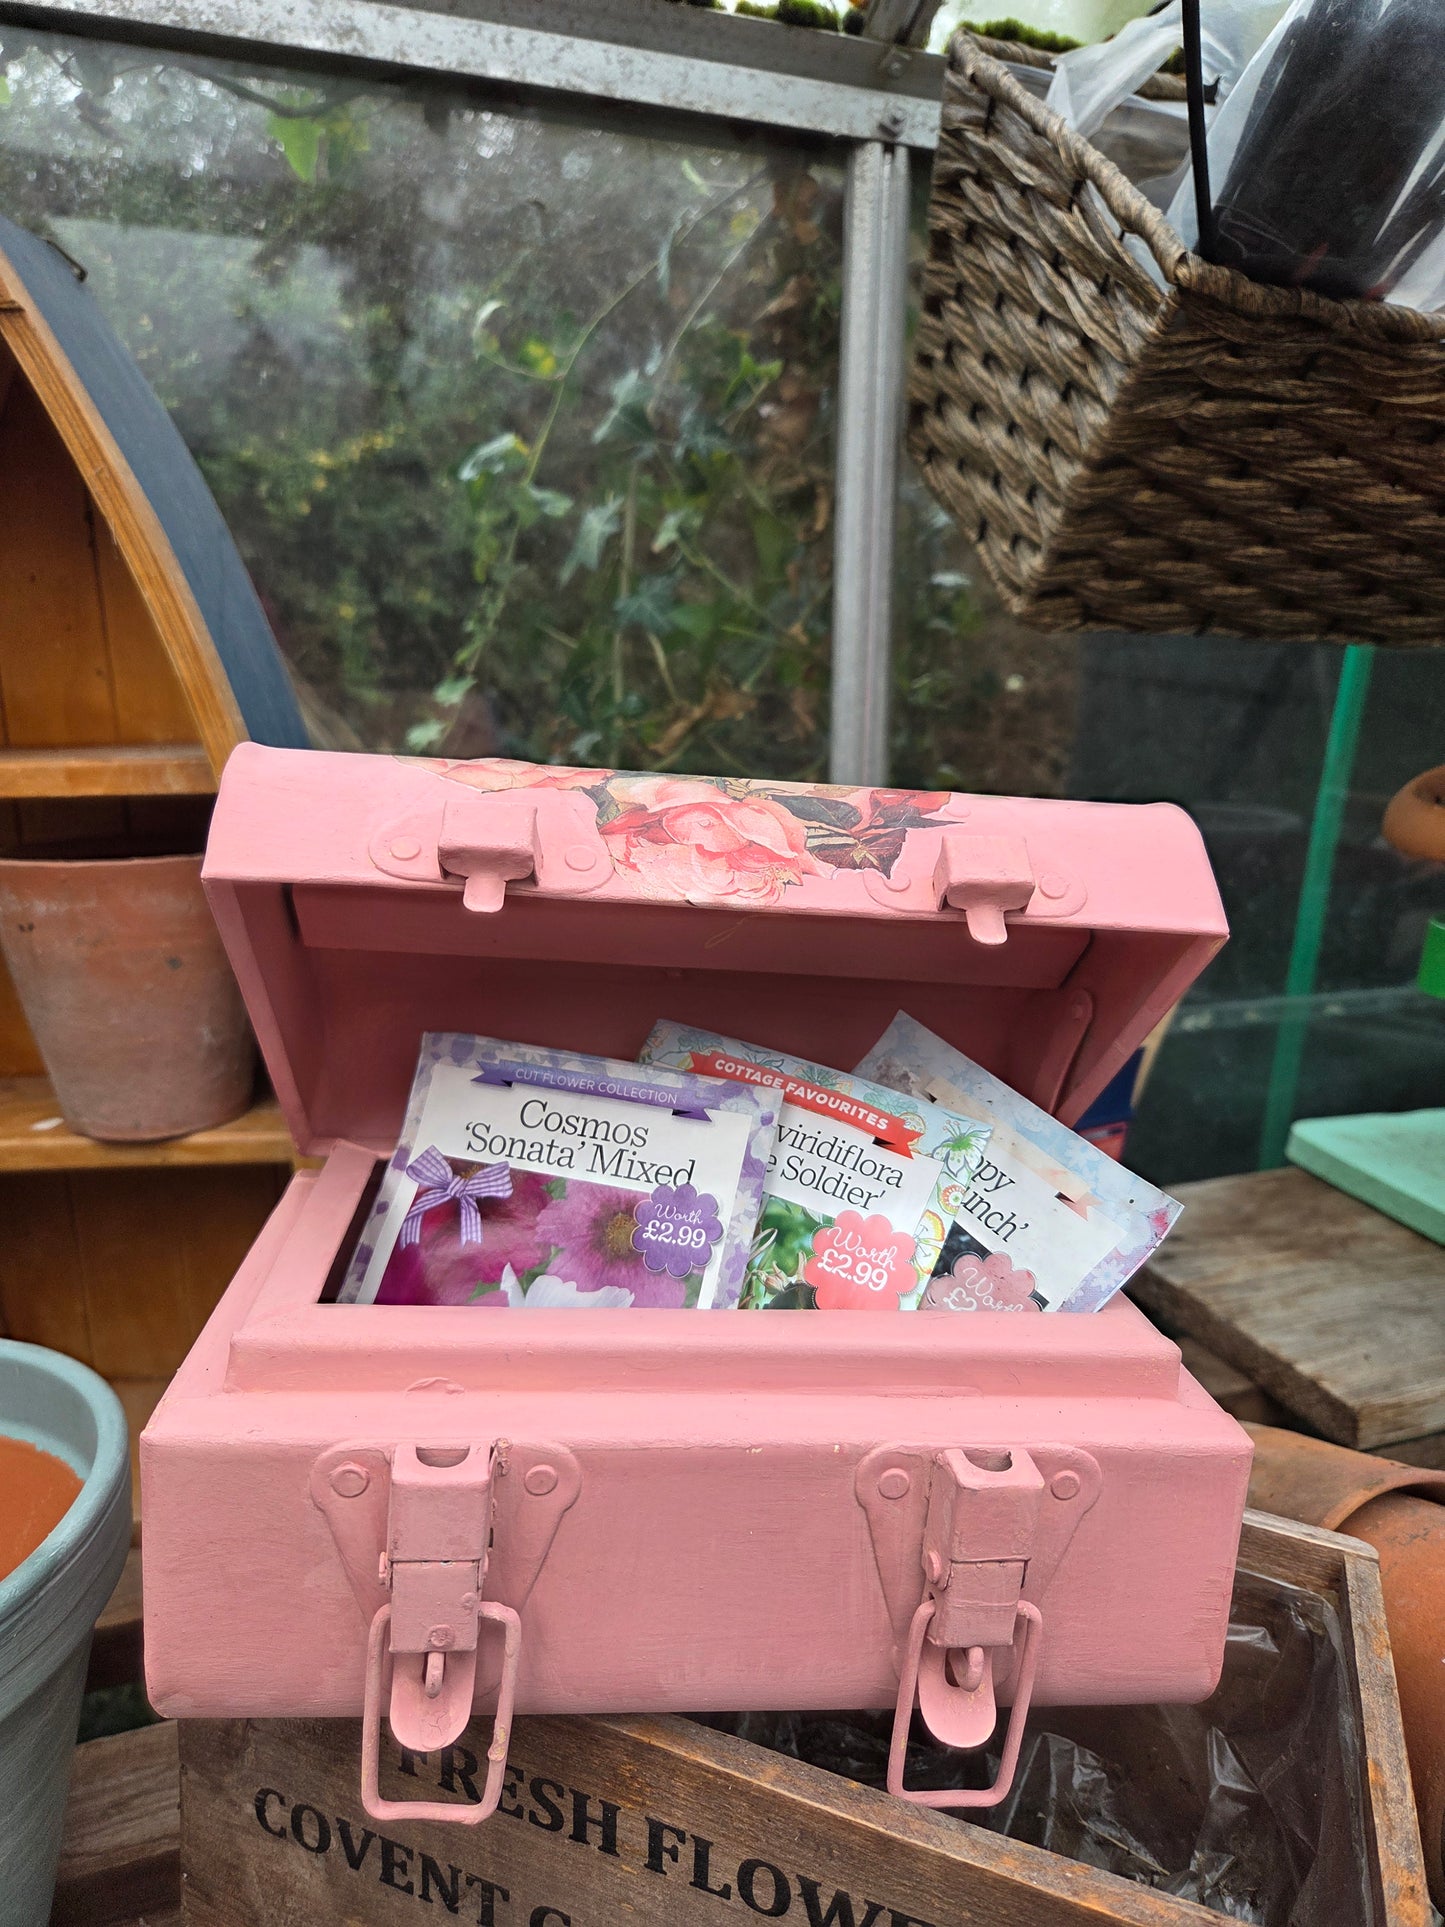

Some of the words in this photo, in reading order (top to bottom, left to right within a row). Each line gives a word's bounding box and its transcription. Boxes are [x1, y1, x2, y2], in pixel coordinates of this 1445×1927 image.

[515, 1068, 541, 1081] CUT
[542, 1071, 595, 1091] FLOWER
[598, 1082, 678, 1104] COLLECTION
[715, 1059, 784, 1089] COTTAGE
[785, 1080, 889, 1131] FAVOURITES
[519, 1099, 650, 1148] Cosmos
[586, 1144, 696, 1188] Mixed
[777, 1123, 905, 1189] viridiflora
[642, 1219, 707, 1248] £2.99
[654, 1203, 704, 1225] Worth
[816, 1248, 889, 1292] £2.99
[826, 1226, 897, 1271] Worth
[254, 1787, 511, 1927] COVENT
